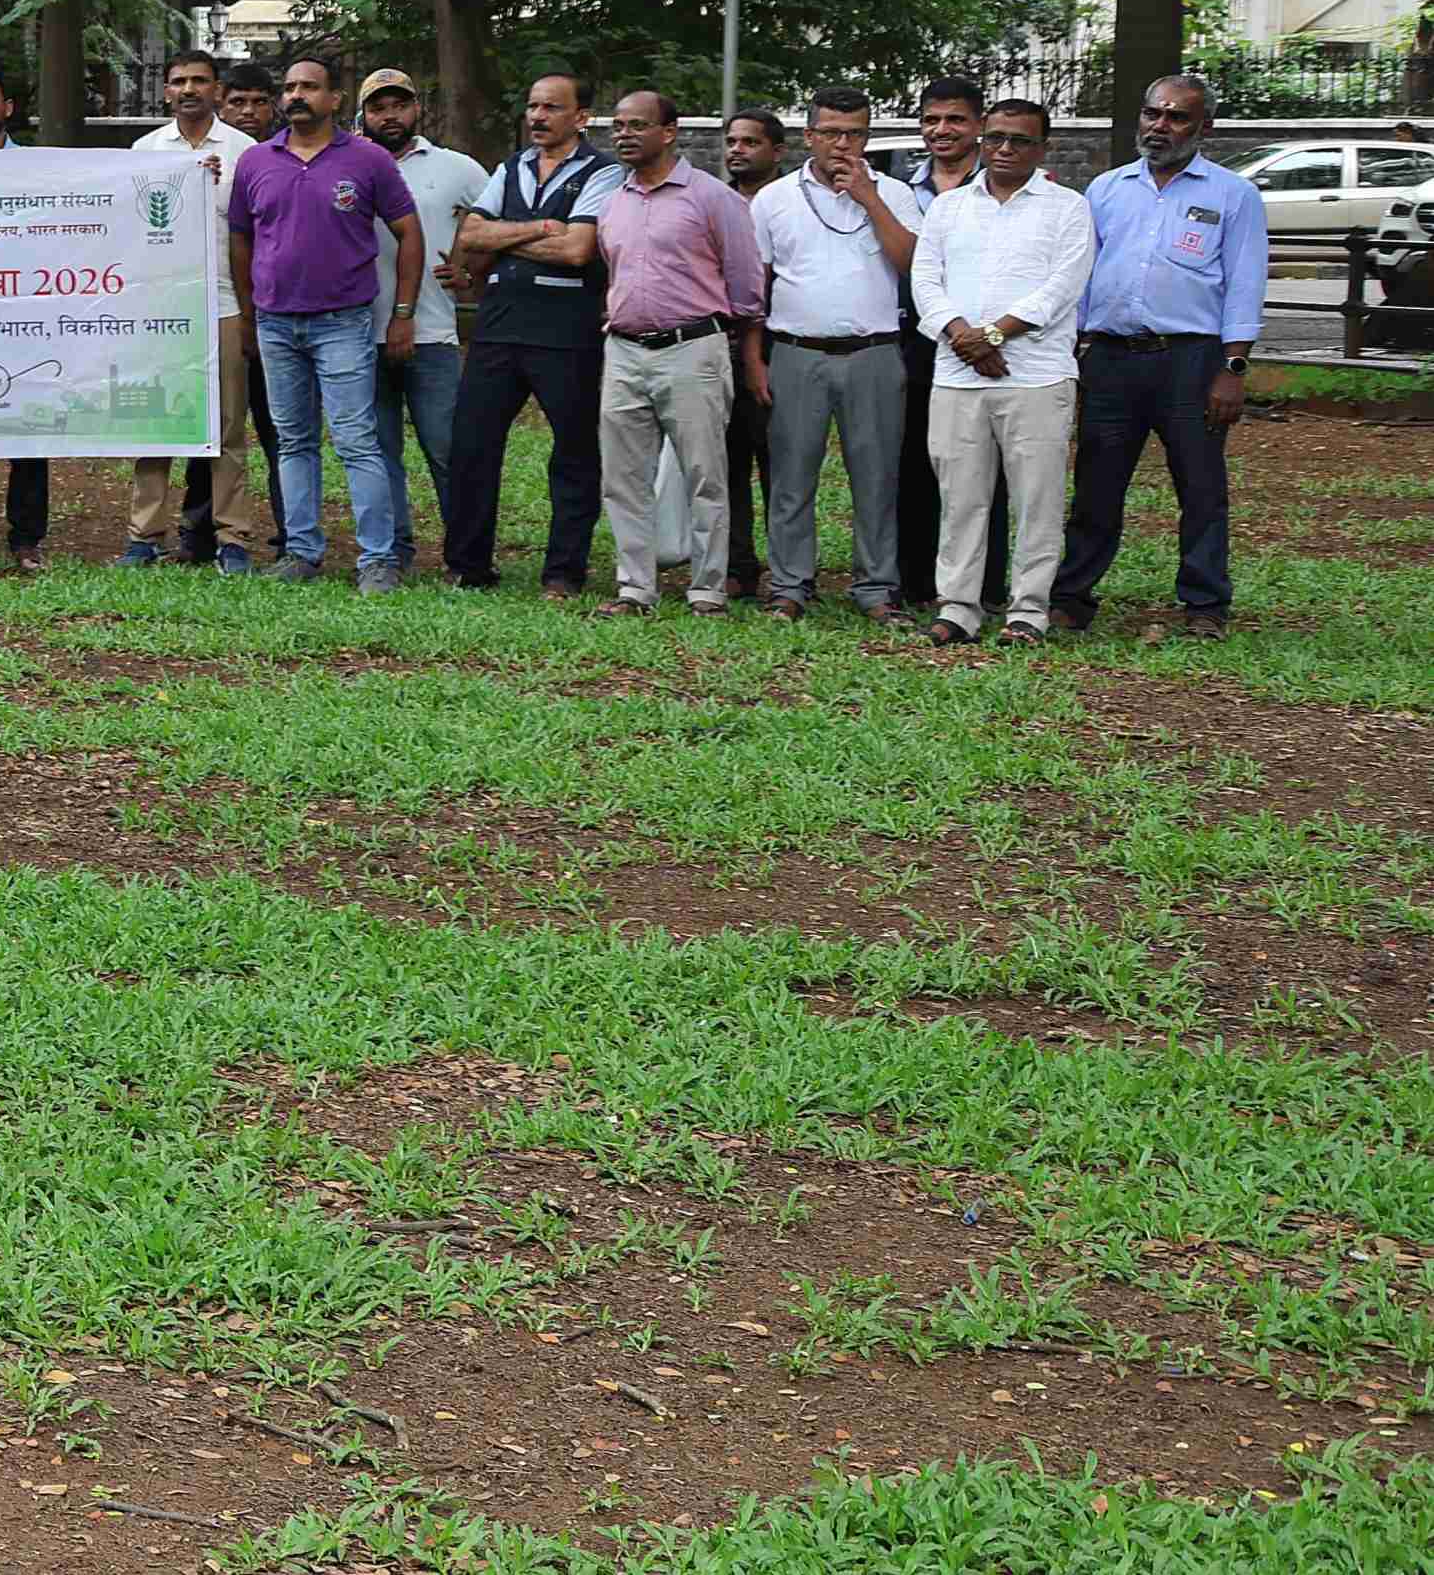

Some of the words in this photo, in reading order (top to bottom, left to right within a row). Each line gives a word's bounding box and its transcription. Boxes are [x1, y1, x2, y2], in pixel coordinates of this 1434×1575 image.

[60, 192, 114, 208] संस्थान
[26, 225, 57, 236] भारत
[33, 263, 124, 297] 2026
[58, 314, 136, 336] विकसित
[144, 318, 192, 335] भारत
